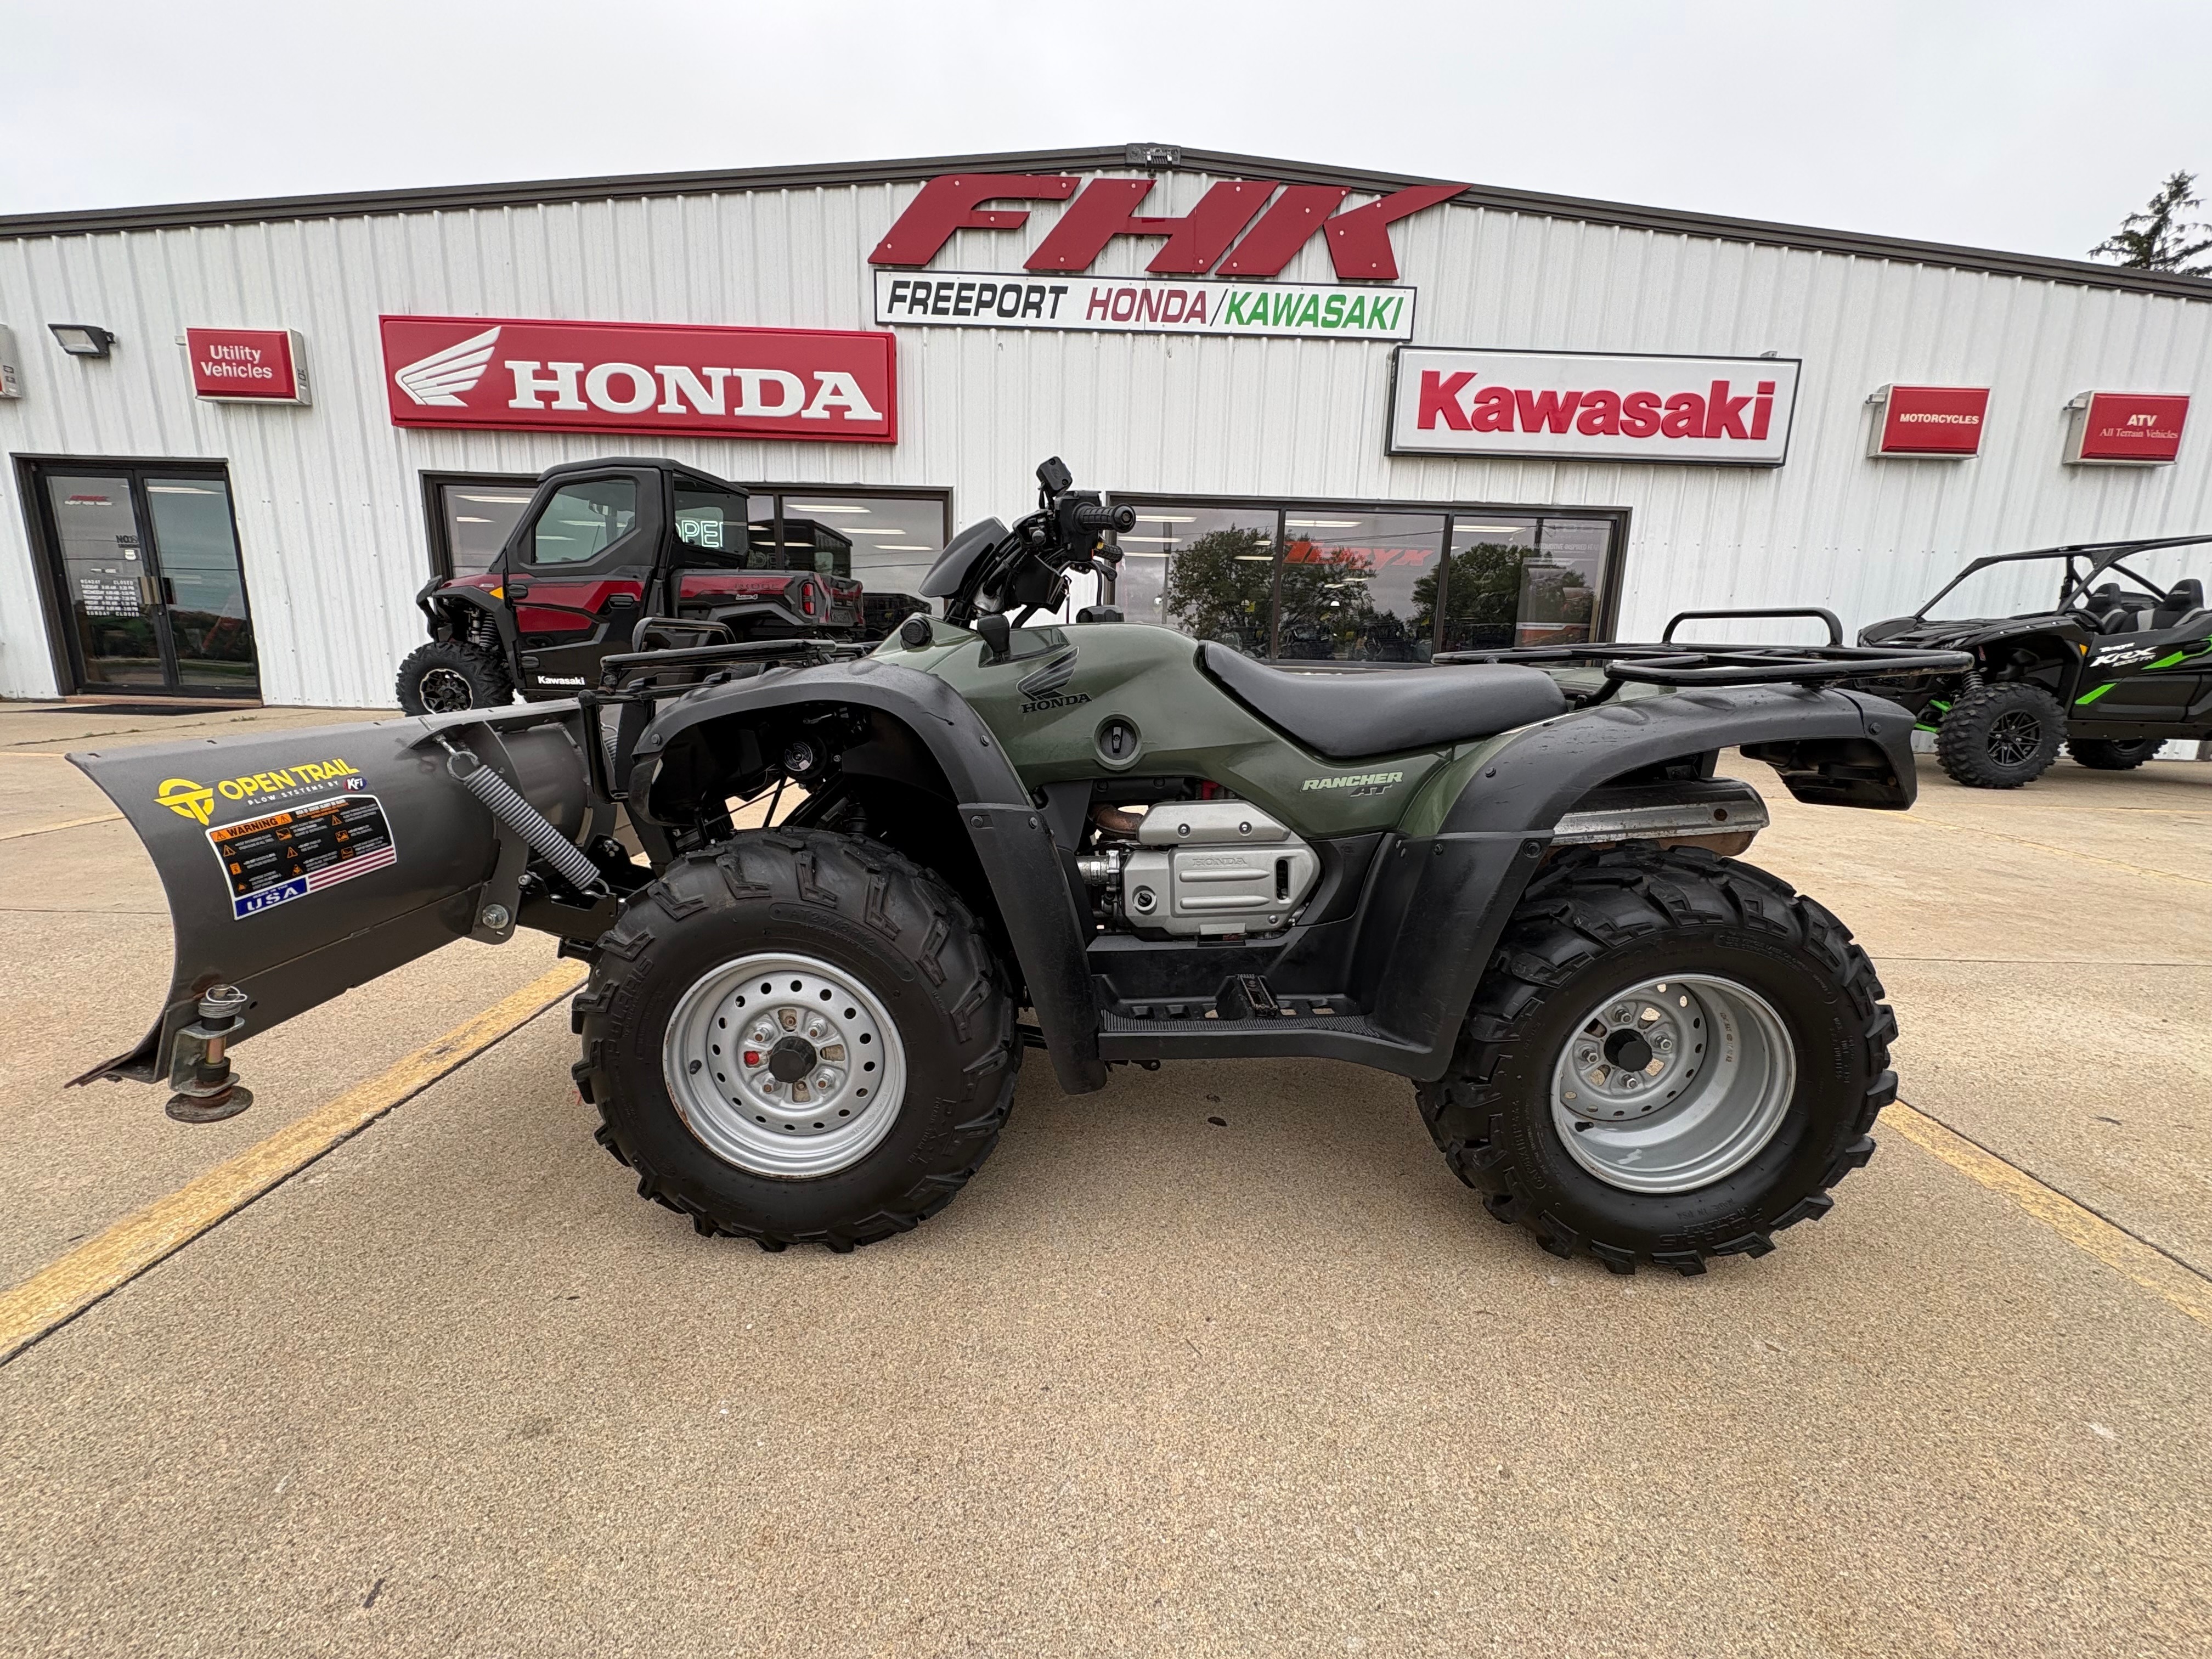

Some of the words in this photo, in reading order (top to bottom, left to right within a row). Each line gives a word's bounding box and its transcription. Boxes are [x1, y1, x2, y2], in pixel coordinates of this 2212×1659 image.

[868, 173, 1471, 280] FHK
[888, 281, 1068, 318] FREEPORT
[210, 345, 261, 364] Utility
[200, 362, 273, 379] Vehicles
[504, 360, 883, 420] HONDA
[1418, 370, 1775, 440] Kawasaki
[1899, 413, 1979, 424] MOTORCYCLES
[2126, 414, 2157, 426] ATV
[2099, 427, 2114, 436] All
[2116, 428, 2143, 437] Terrain
[2146, 429, 2178, 438] Vehicles
[675, 521, 723, 548] PE
[2089, 646, 2159, 667] KRX
[538, 676, 585, 685] Kawasaki
[1020, 693, 1093, 713] HONDA
[218, 770, 297, 800] OPEN
[289, 758, 360, 784] TRAIL
[1302, 771, 1403, 791] RANCHER
[248, 794, 276, 805] PLOW
[283, 783, 324, 798] SYSTEMS
[1350, 784, 1393, 798] AT
[227, 817, 279, 837] WARNING
[1192, 857, 1247, 866] HONDA
[247, 887, 298, 911] USA
